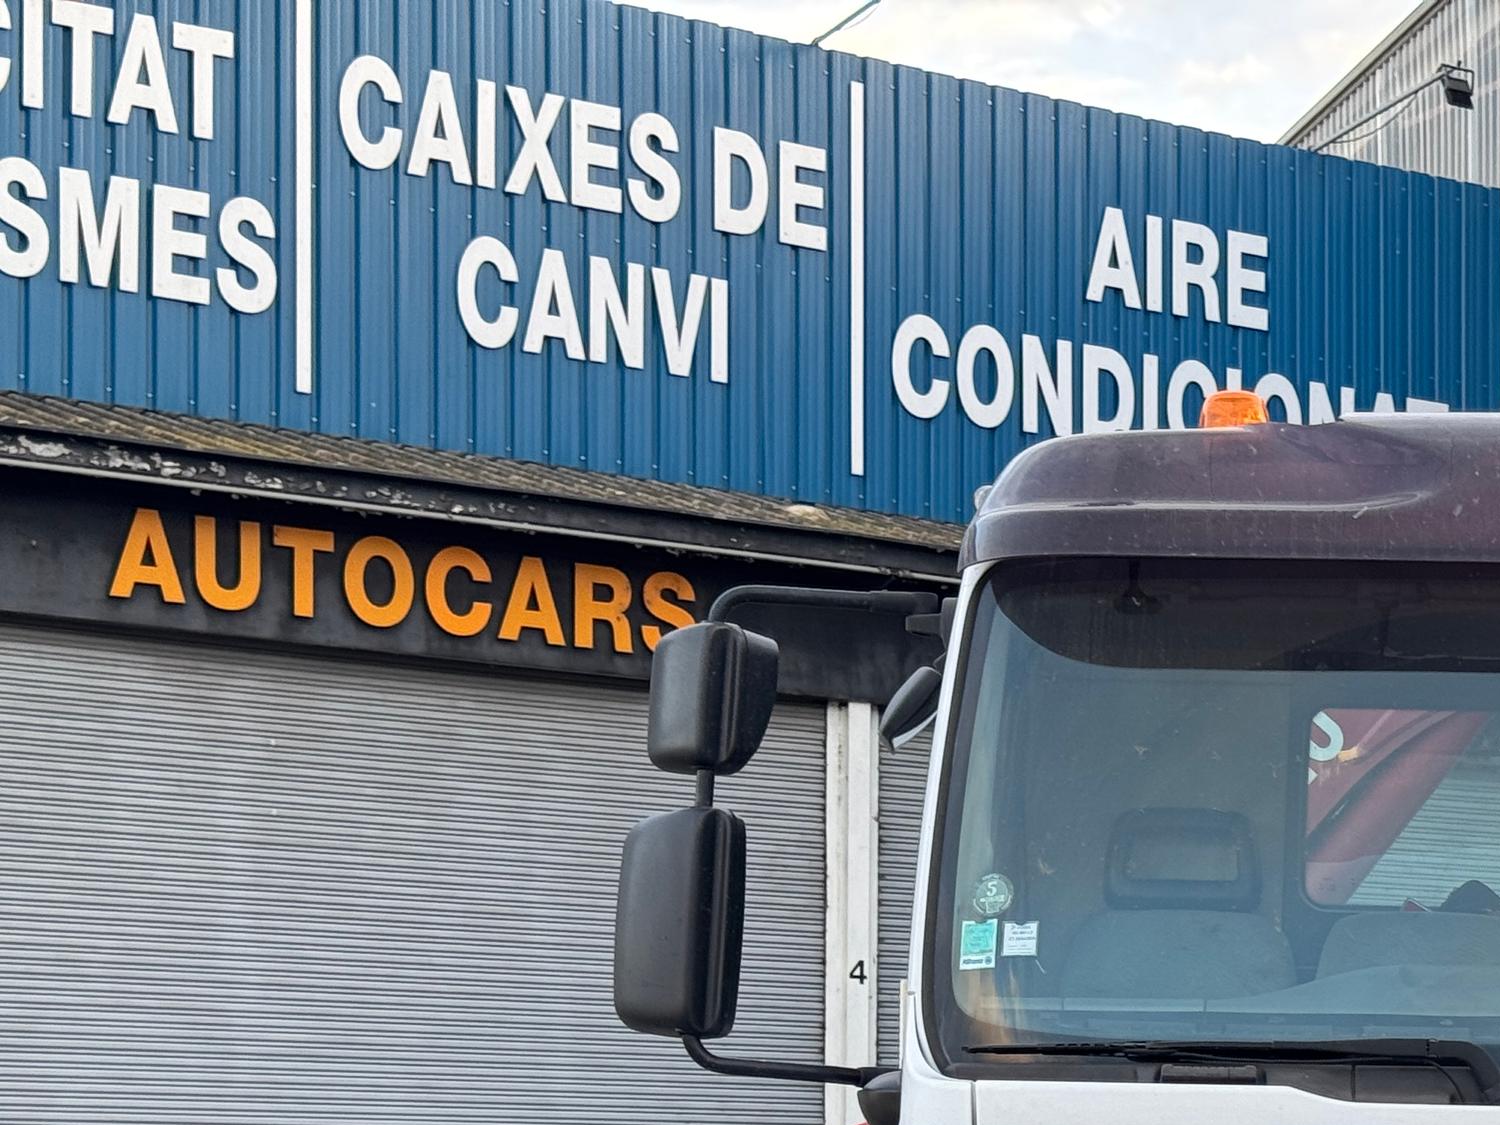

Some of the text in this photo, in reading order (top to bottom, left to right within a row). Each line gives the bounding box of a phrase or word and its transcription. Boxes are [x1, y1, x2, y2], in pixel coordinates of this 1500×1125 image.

[0, 0, 235, 140] ITAT
[339, 54, 828, 252] CAIXES DE
[457, 235, 729, 384] CANVI
[1086, 206, 1269, 331] AIRE
[109, 509, 696, 653] AUTOCARS
[849, 959, 868, 985] 4
